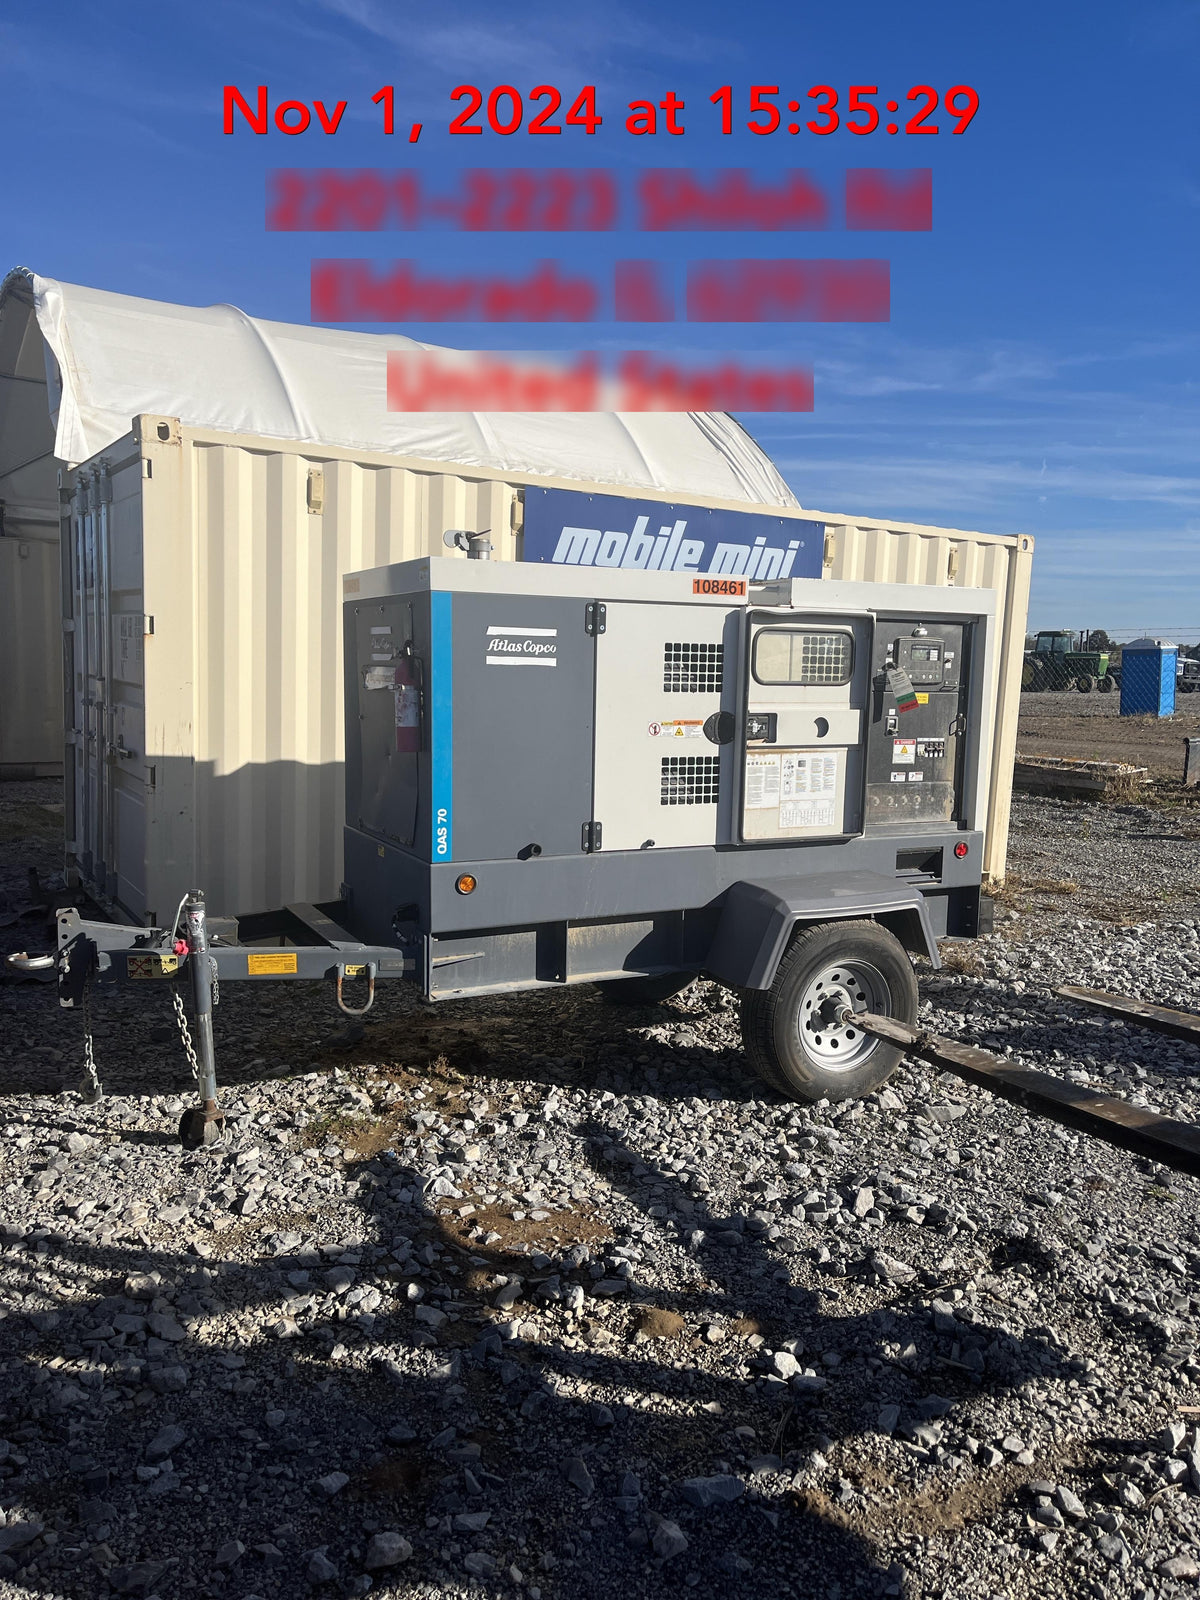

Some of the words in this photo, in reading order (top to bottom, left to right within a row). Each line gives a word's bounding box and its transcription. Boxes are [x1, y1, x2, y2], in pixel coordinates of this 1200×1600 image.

[551, 515, 705, 573] mobile
[707, 536, 800, 581] mini
[694, 578, 744, 595] 108461
[487, 638, 522, 652] Atlas
[523, 639, 557, 655] Copco
[437, 808, 448, 825] 70
[437, 826, 448, 855] QAS
